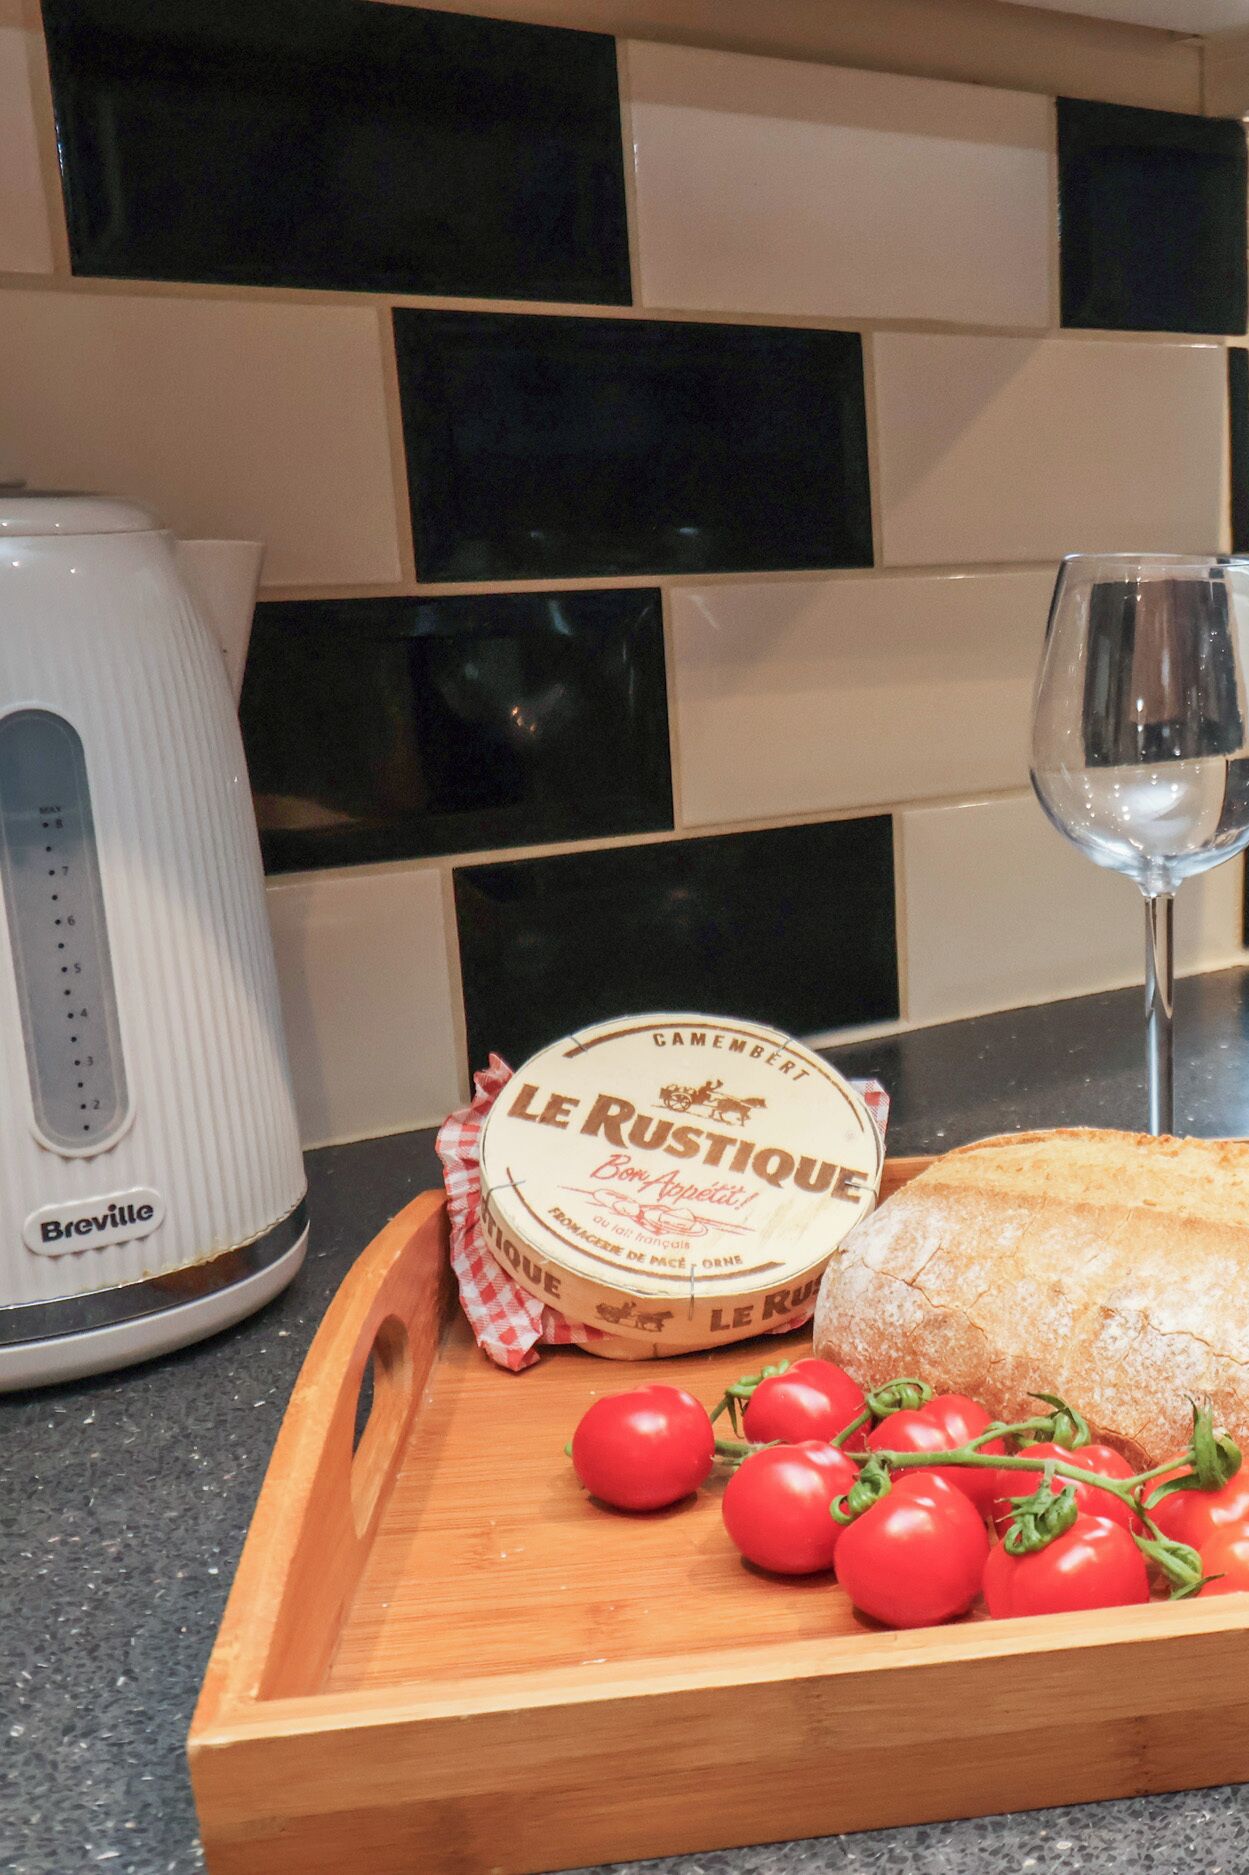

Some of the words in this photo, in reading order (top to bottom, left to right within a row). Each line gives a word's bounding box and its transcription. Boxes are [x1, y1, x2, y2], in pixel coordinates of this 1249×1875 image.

[62, 866, 68, 876] 7
[67, 915, 76, 926] 6
[74, 963, 82, 973] 5
[80, 1008, 88, 1018] 4
[86, 1056, 93, 1066] 3
[93, 1100, 100, 1110] 2
[507, 1083, 580, 1139] LE
[580, 1093, 869, 1204] RUSTIQUE
[590, 1154, 650, 1182] Bon
[40, 1204, 154, 1243] Breville
[593, 1215, 609, 1228] au
[635, 1232, 691, 1250] français
[547, 1206, 625, 1257] FROMAGERIE
[626, 1250, 646, 1263] DE
[702, 1255, 744, 1269] ORNE
[710, 1305, 754, 1332] LE
